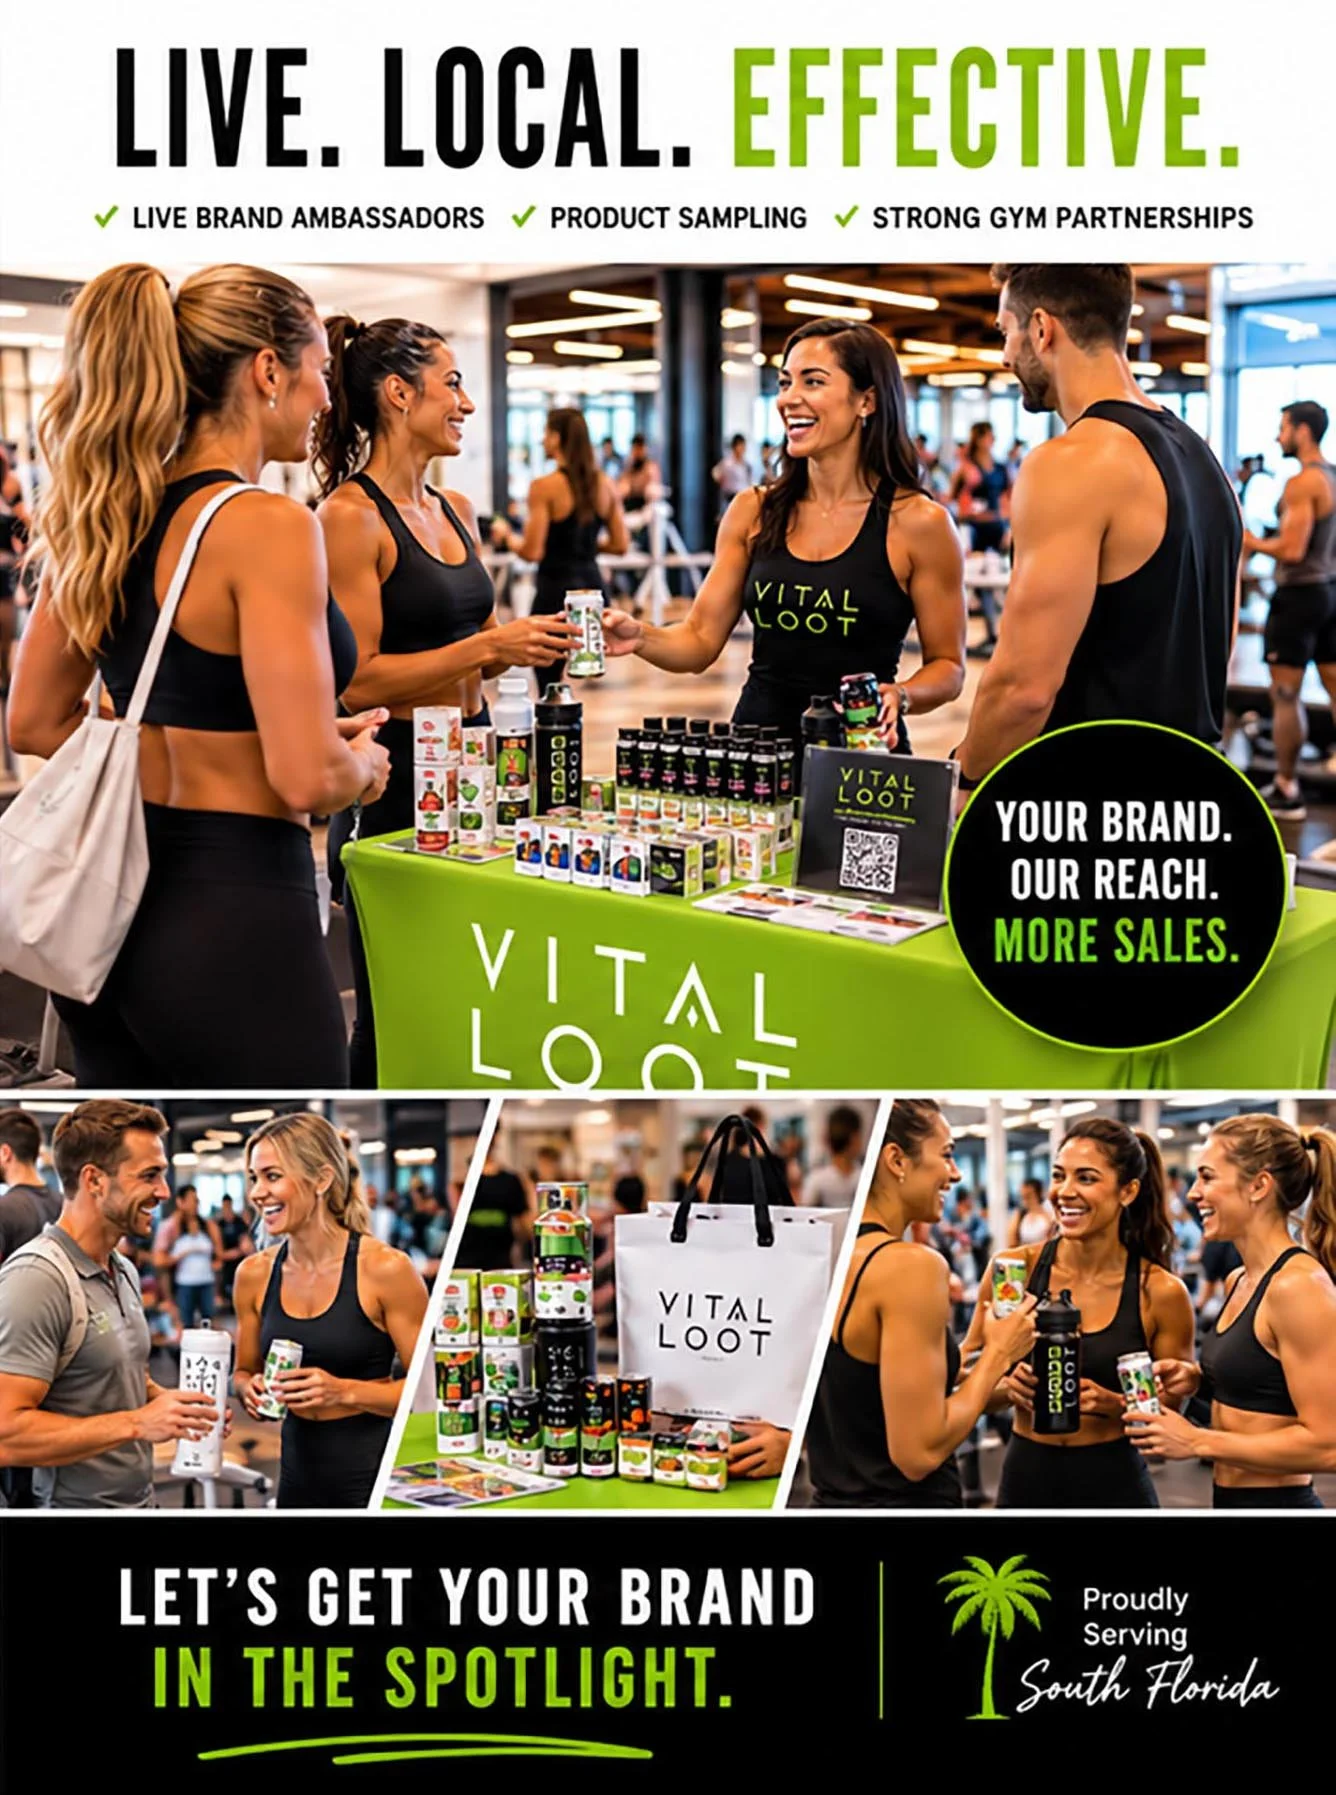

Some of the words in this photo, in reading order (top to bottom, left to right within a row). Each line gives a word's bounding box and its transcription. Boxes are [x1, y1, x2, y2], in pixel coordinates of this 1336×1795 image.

[754, 580, 859, 613] VITAL
[754, 607, 857, 637] LOOT
[840, 766, 916, 792] VITAL
[838, 785, 915, 811] LOOT
[471, 923, 798, 1048] VITAL
[659, 1291, 772, 1323] VITAL
[659, 1323, 772, 1357] LOOT
